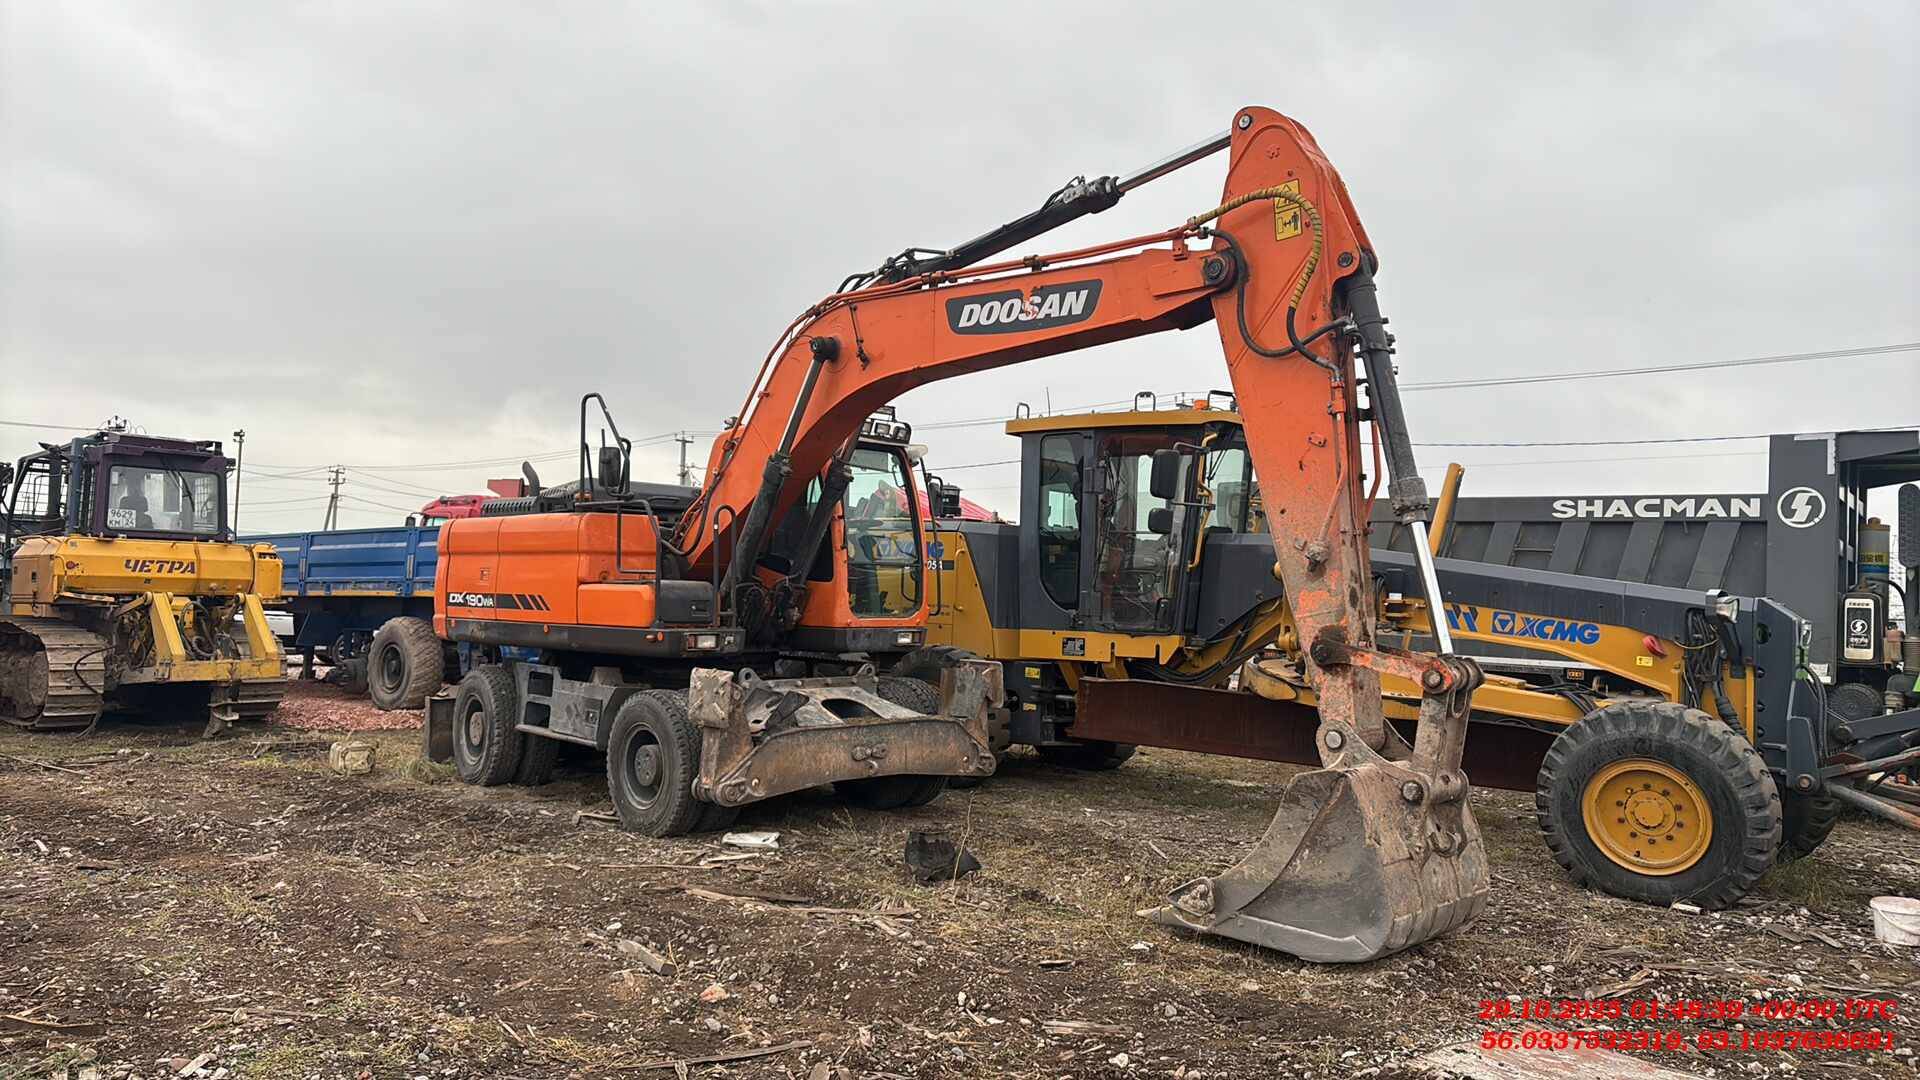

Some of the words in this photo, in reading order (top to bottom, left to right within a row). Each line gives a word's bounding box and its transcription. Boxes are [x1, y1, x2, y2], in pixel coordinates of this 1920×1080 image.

[958, 289, 1089, 328] DOOSAN
[110, 509, 133, 519] 9629
[1551, 497, 1761, 519] SHACMAN
[125, 560, 195, 574] ЧЕТРА
[1516, 616, 1600, 645] XCMG
